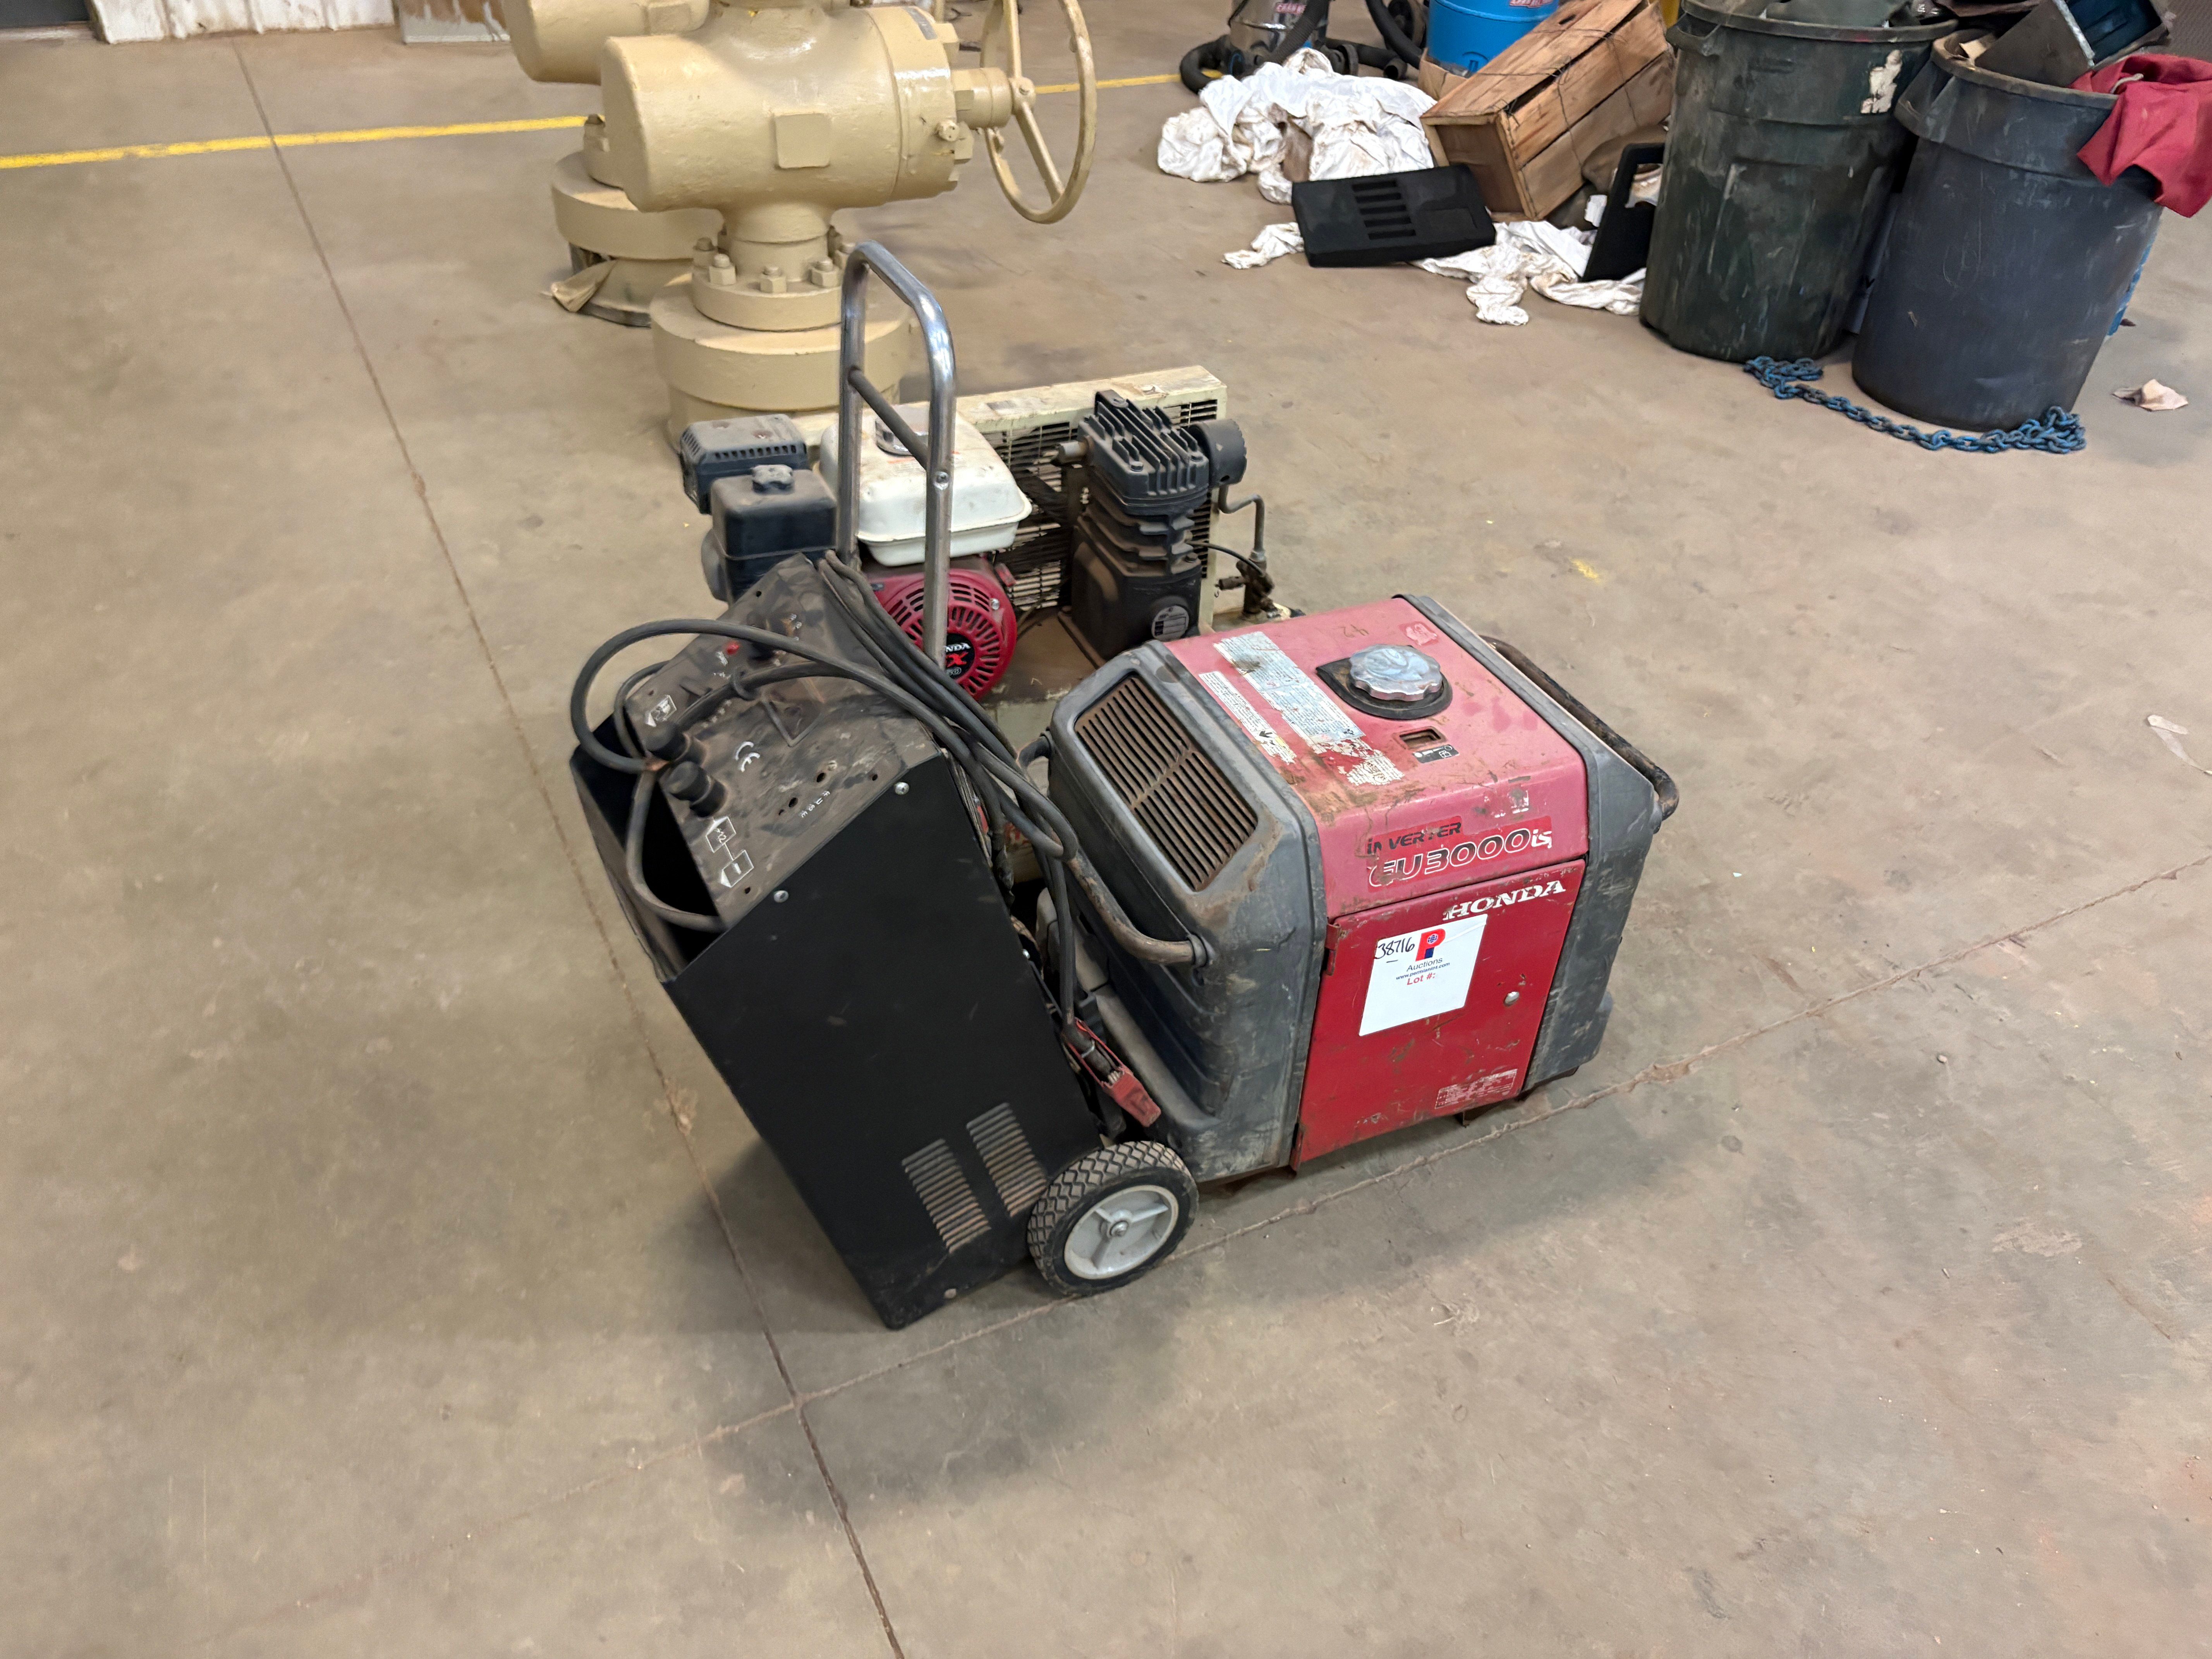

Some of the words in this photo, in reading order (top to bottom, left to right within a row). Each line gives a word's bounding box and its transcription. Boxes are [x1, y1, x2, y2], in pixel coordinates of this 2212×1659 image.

[946, 642, 971, 653] NDA
[735, 741, 761, 772] CE
[800, 791, 830, 818] FUSE
[1443, 880, 1566, 921] HONDA
[1374, 937, 1415, 959] 38716
[1406, 958, 1443, 972] Auctions
[1407, 975, 1424, 985] Lot
